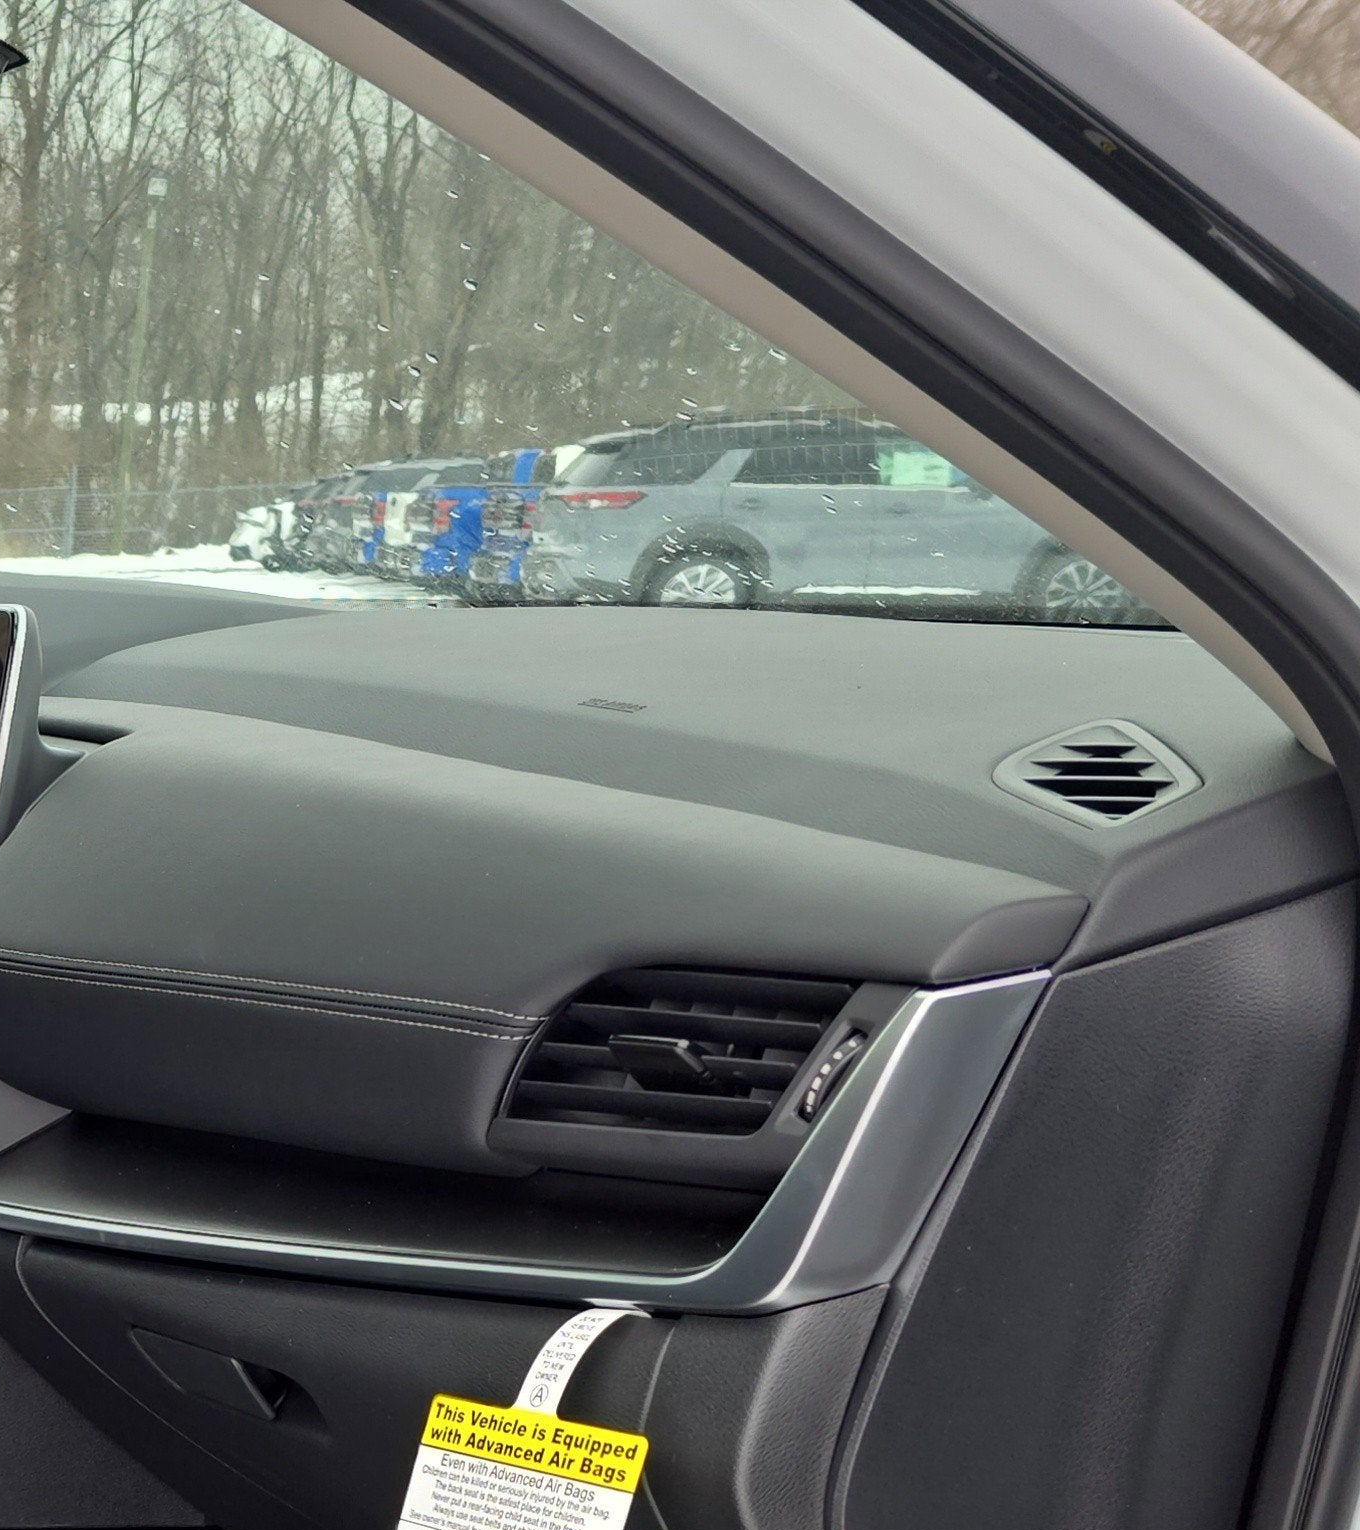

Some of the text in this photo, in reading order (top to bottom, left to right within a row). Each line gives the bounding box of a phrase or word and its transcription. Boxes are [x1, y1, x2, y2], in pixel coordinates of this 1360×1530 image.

[431, 1427, 627, 1483] with Advanced Air Bags
[436, 1402, 638, 1460] This Vehicle is Equipped
[422, 1464, 610, 1520] Children can be killed or seriously injured by the air bag.
[441, 1453, 595, 1502] Even with Advanced Air Bags
[435, 1479, 586, 1526] The back seat is the safest place for children.
[450, 1497, 461, 1507] put
[468, 1501, 504, 1519] rear-facing
[505, 1510, 521, 1522] child
[523, 1515, 539, 1526] seat
[540, 1519, 548, 1529] in
[456, 1511, 468, 1520] use
[469, 1513, 484, 1524] seat
[484, 1517, 502, 1529] belts
